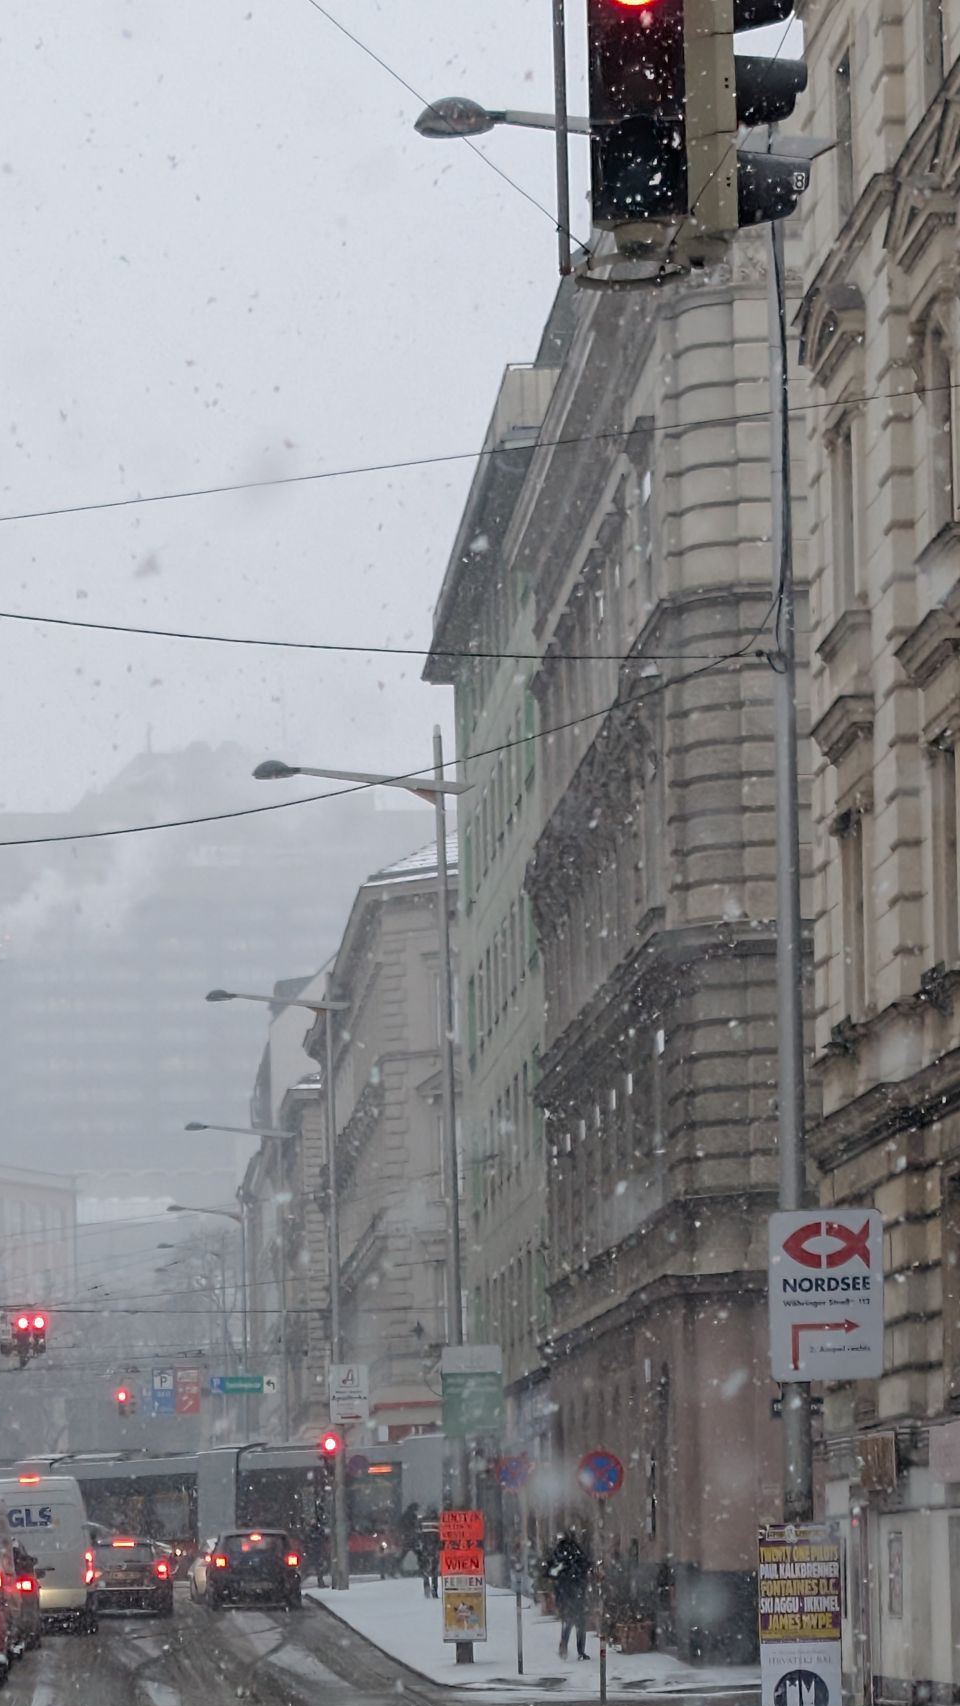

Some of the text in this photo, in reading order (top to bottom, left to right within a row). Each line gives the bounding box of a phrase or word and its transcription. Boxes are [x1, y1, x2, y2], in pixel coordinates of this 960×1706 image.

[795, 175, 804, 189] 8
[782, 1276, 871, 1293] NORDSEE
[7, 1506, 52, 1528] GLS
[760, 1544, 839, 1563] TWENTY ONE PILOTS
[445, 1559, 480, 1570] WIEN
[760, 1562, 840, 1578] PAUL KALKBRENNER
[761, 1580, 819, 1597] FONTAINES
[760, 1596, 840, 1613] SKI AGGU IKKIMEL
[768, 1613, 833, 1630] JAMES HYPE
